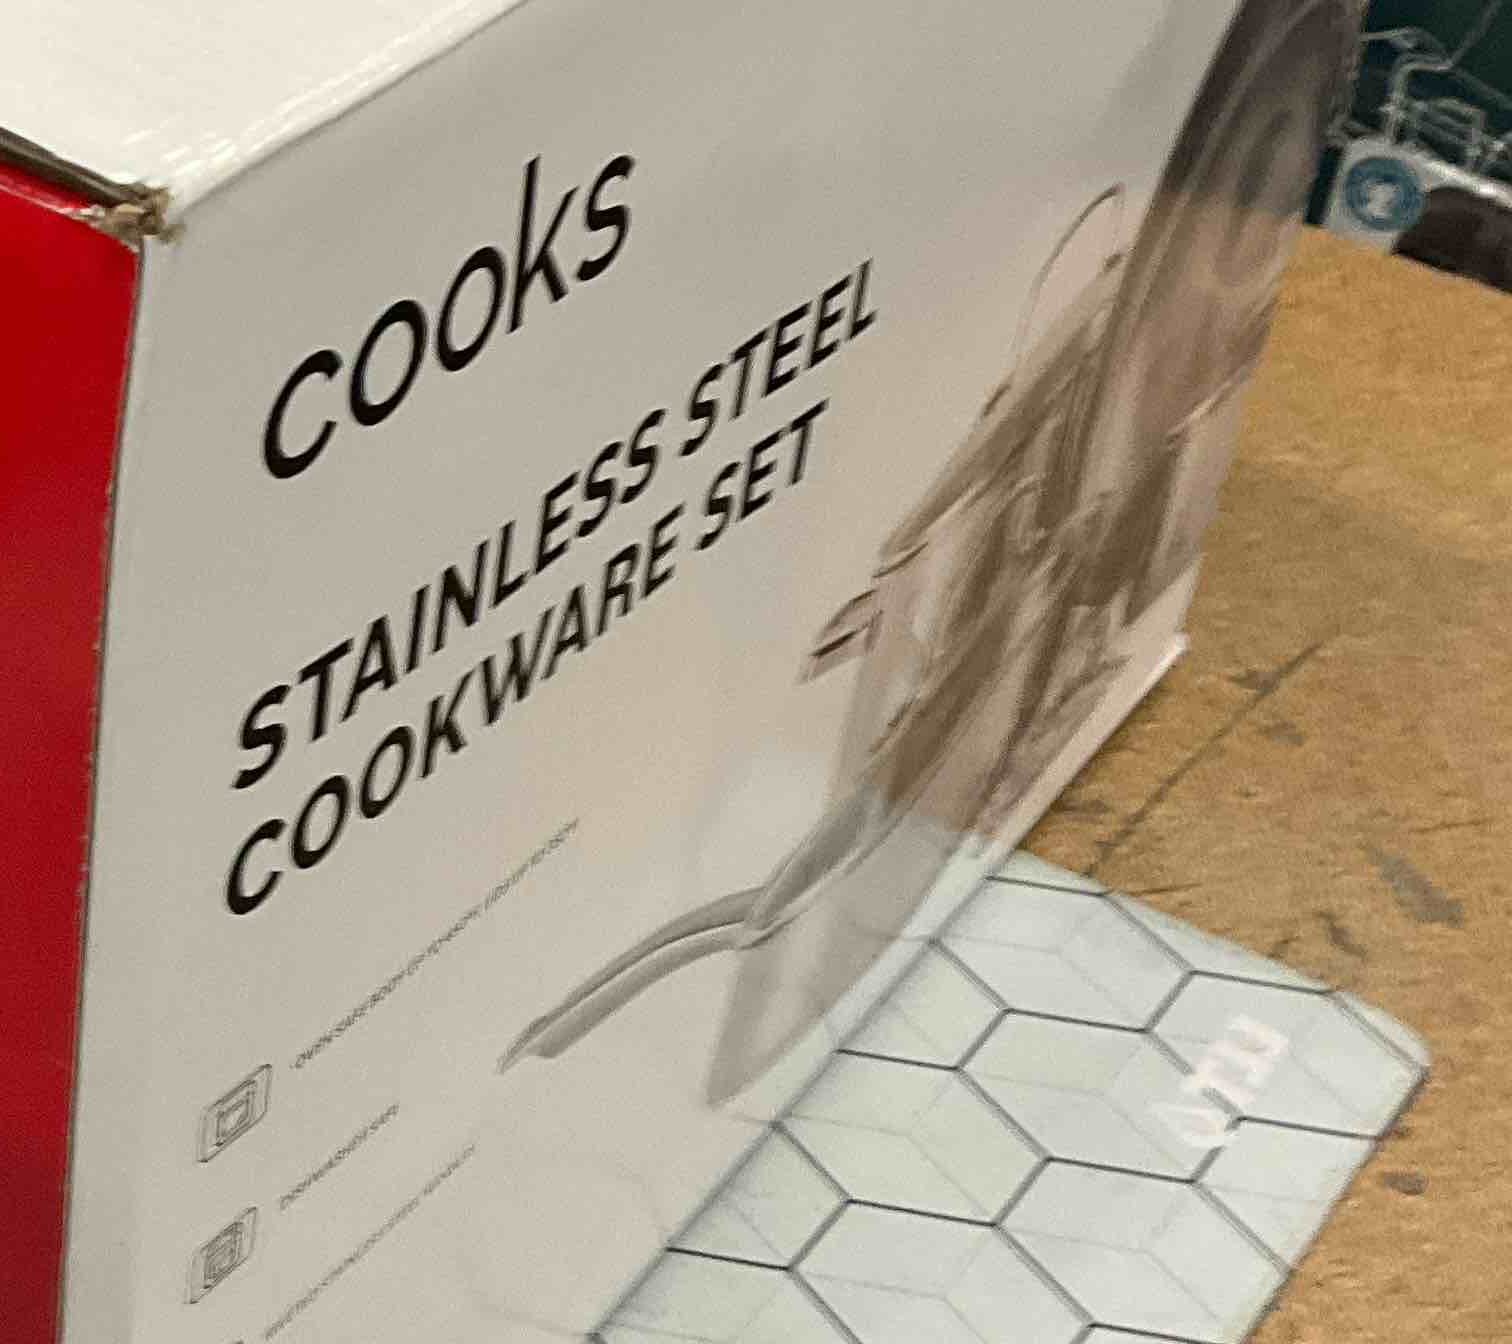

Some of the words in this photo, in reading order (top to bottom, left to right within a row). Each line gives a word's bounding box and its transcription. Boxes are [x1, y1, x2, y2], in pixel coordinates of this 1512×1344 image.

[230, 408, 667, 791] STAINLESS
[679, 258, 877, 458] STEEL
[262, 154, 636, 481] cooks
[225, 503, 685, 917] COOKWARE
[694, 398, 829, 552] SET
